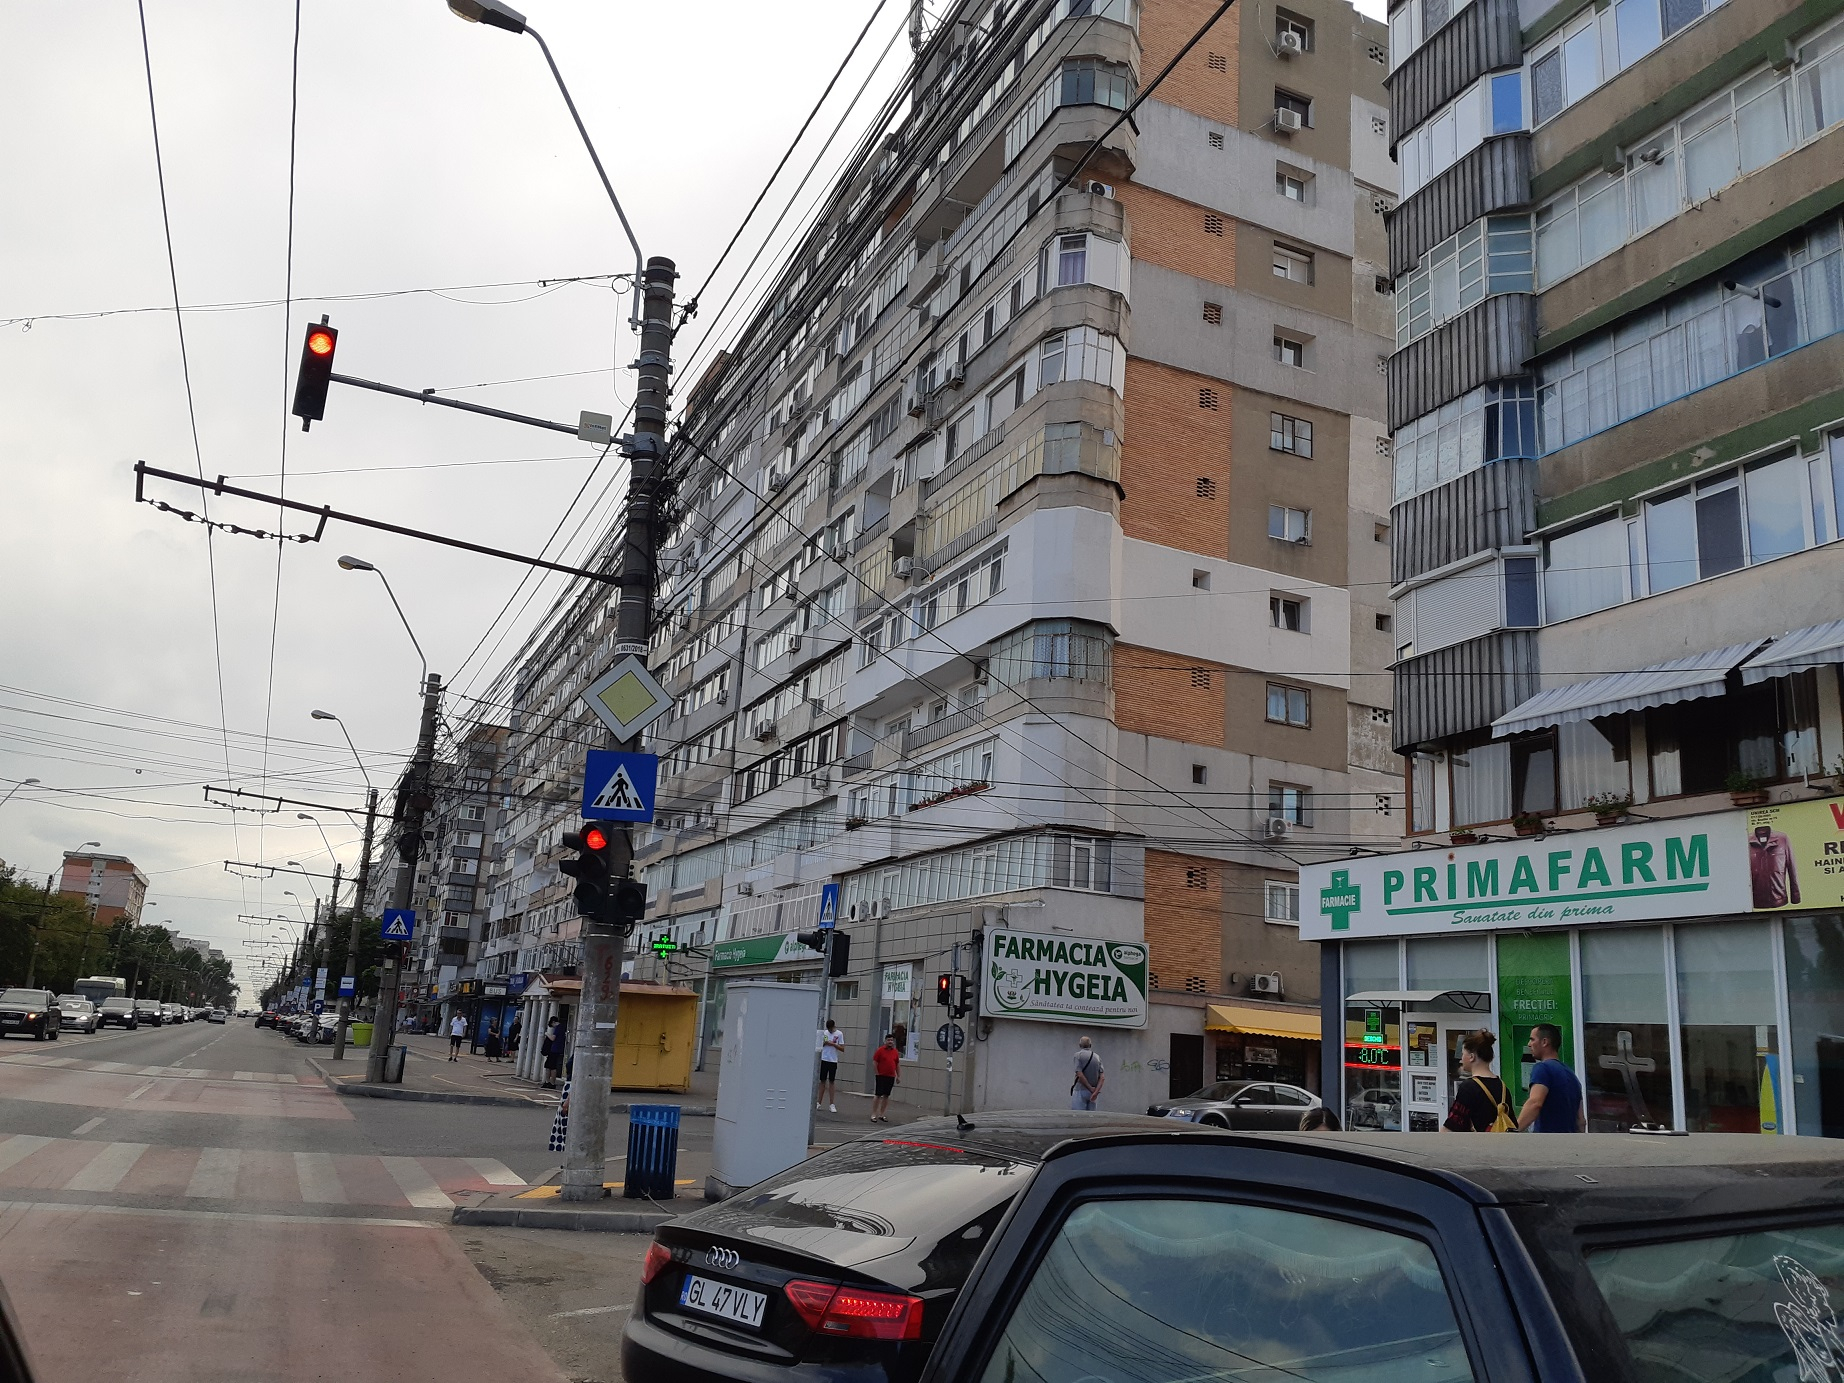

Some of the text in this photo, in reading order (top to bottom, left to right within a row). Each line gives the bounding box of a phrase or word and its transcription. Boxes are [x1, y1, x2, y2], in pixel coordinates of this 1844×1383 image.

[1383, 833, 1711, 906] PRIMAFARM
[1824, 867, 1835, 875] SI
[1321, 894, 1357, 908] FARMACIE
[1450, 904, 1615, 925] Sanatate din prima
[714, 949, 732, 962] Farmacia
[993, 934, 1108, 968] FARMACIA
[884, 971, 909, 982] FARMACIA
[1034, 968, 1128, 1003] HYGEIA
[314, 1003, 322, 1011] P
[1065, 1002, 1073, 1010] ta
[1104, 1005, 1127, 1015] pentru
[1127, 1006, 1139, 1014] noi
[689, 1279, 765, 1322] GL 47 VLY
